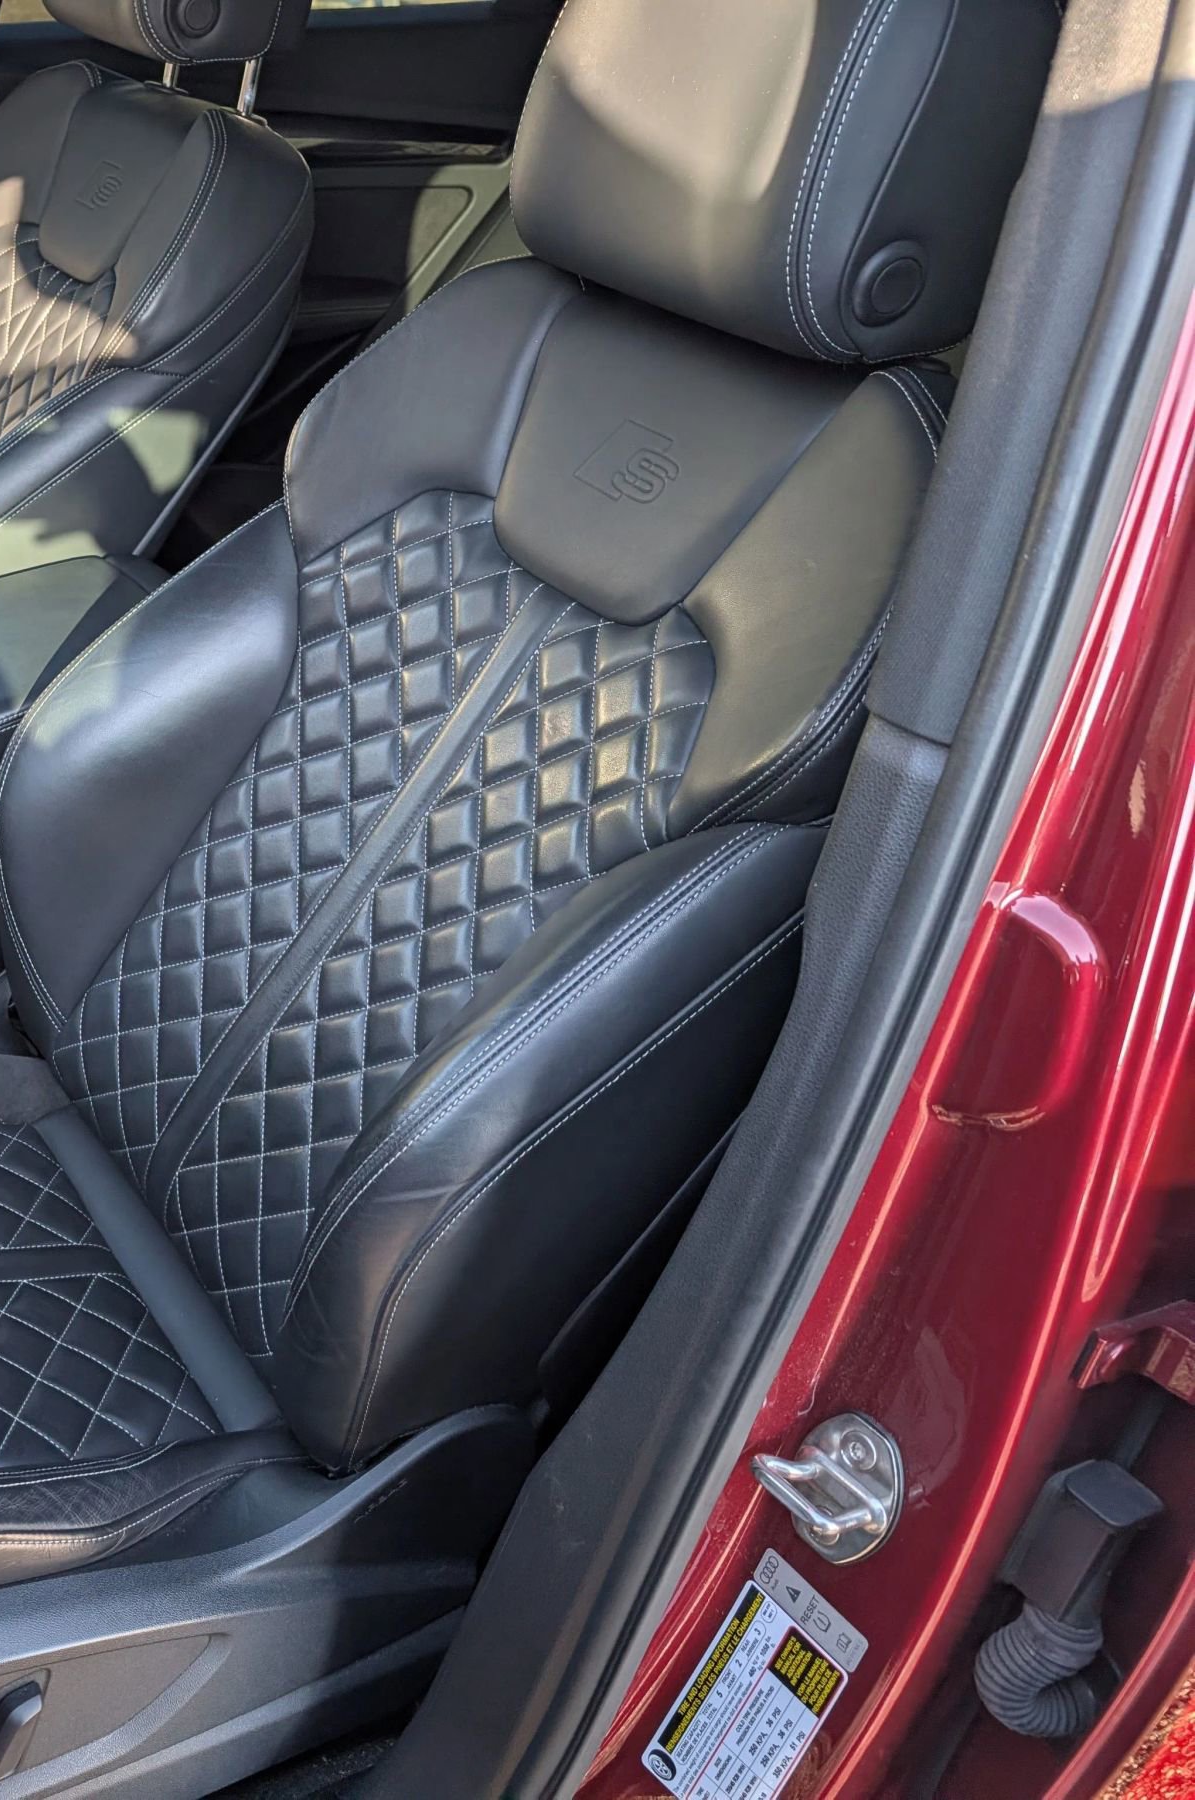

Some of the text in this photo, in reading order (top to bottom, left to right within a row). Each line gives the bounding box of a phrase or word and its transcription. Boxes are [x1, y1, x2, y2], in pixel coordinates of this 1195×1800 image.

[800, 1596, 820, 1625] RESET
[740, 1638, 750, 1652] REAR
[779, 1640, 801, 1675] MANUAL FOR
[665, 1591, 764, 1752] RENSEIGNEMENTS SUR LES PNEUS ET LE CHARGEMENT
[678, 1616, 740, 1716] TIRE AND LOADING INFORMATION
[721, 1668, 732, 1684] FRONT
[773, 1657, 783, 1670] SEE
[786, 1648, 805, 1678] ADDITIONAL
[789, 1650, 813, 1686] INFORMATION
[806, 1655, 822, 1678] MANUEL
[726, 1673, 737, 1689] AVANT
[808, 1688, 820, 1705] POUR
[816, 1675, 827, 1691] PLUS
[735, 1687, 764, 1733] COLD TIRE PRESSURE
[771, 1706, 781, 1719] PSI
[783, 1717, 793, 1731] PSI
[675, 1701, 712, 1758] SEATING CAPACITY TOTAL
[681, 1743, 694, 1763] NOMBRE
[696, 1720, 708, 1738] PLACES
[706, 1705, 717, 1720] TOTAL
[795, 1729, 805, 1743] PSI
